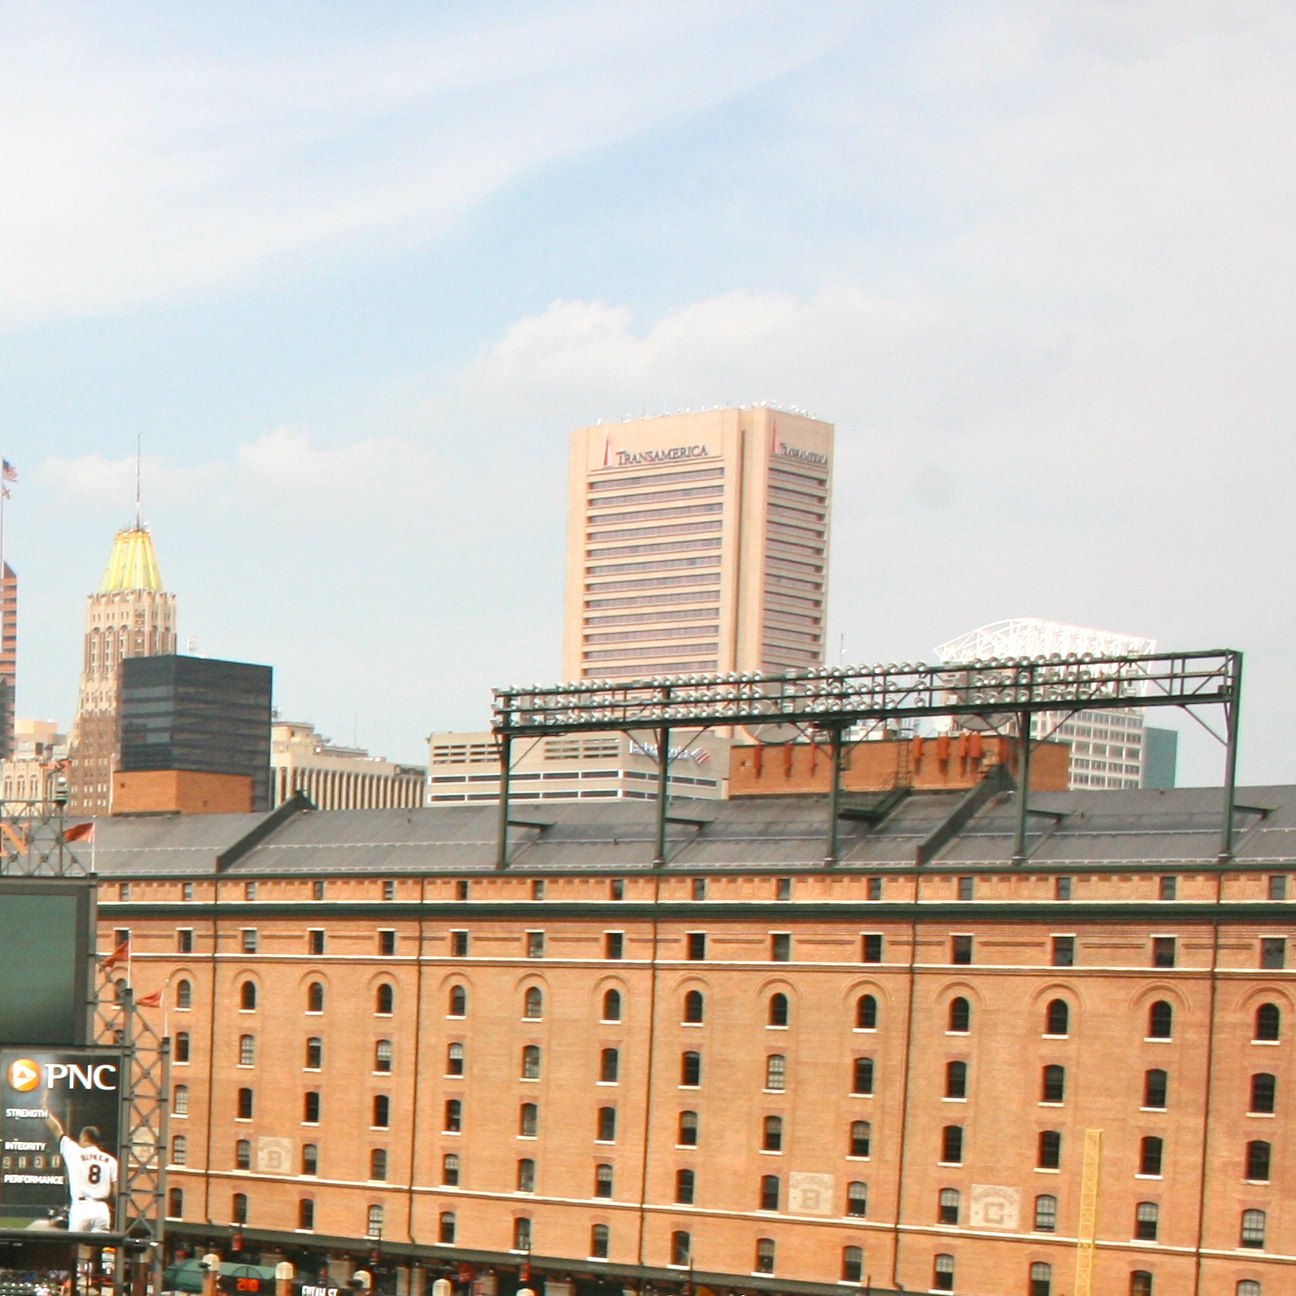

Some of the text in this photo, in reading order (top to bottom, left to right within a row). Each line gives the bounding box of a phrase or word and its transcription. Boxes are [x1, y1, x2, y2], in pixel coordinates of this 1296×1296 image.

[44, 1063, 117, 1091] PNC
[5, 1108, 49, 1119] STRENGTH
[4, 1141, 48, 1152] INTEGRITY
[3, 1174, 65, 1185] PERFORMANCE
[88, 1164, 102, 1185] 8
